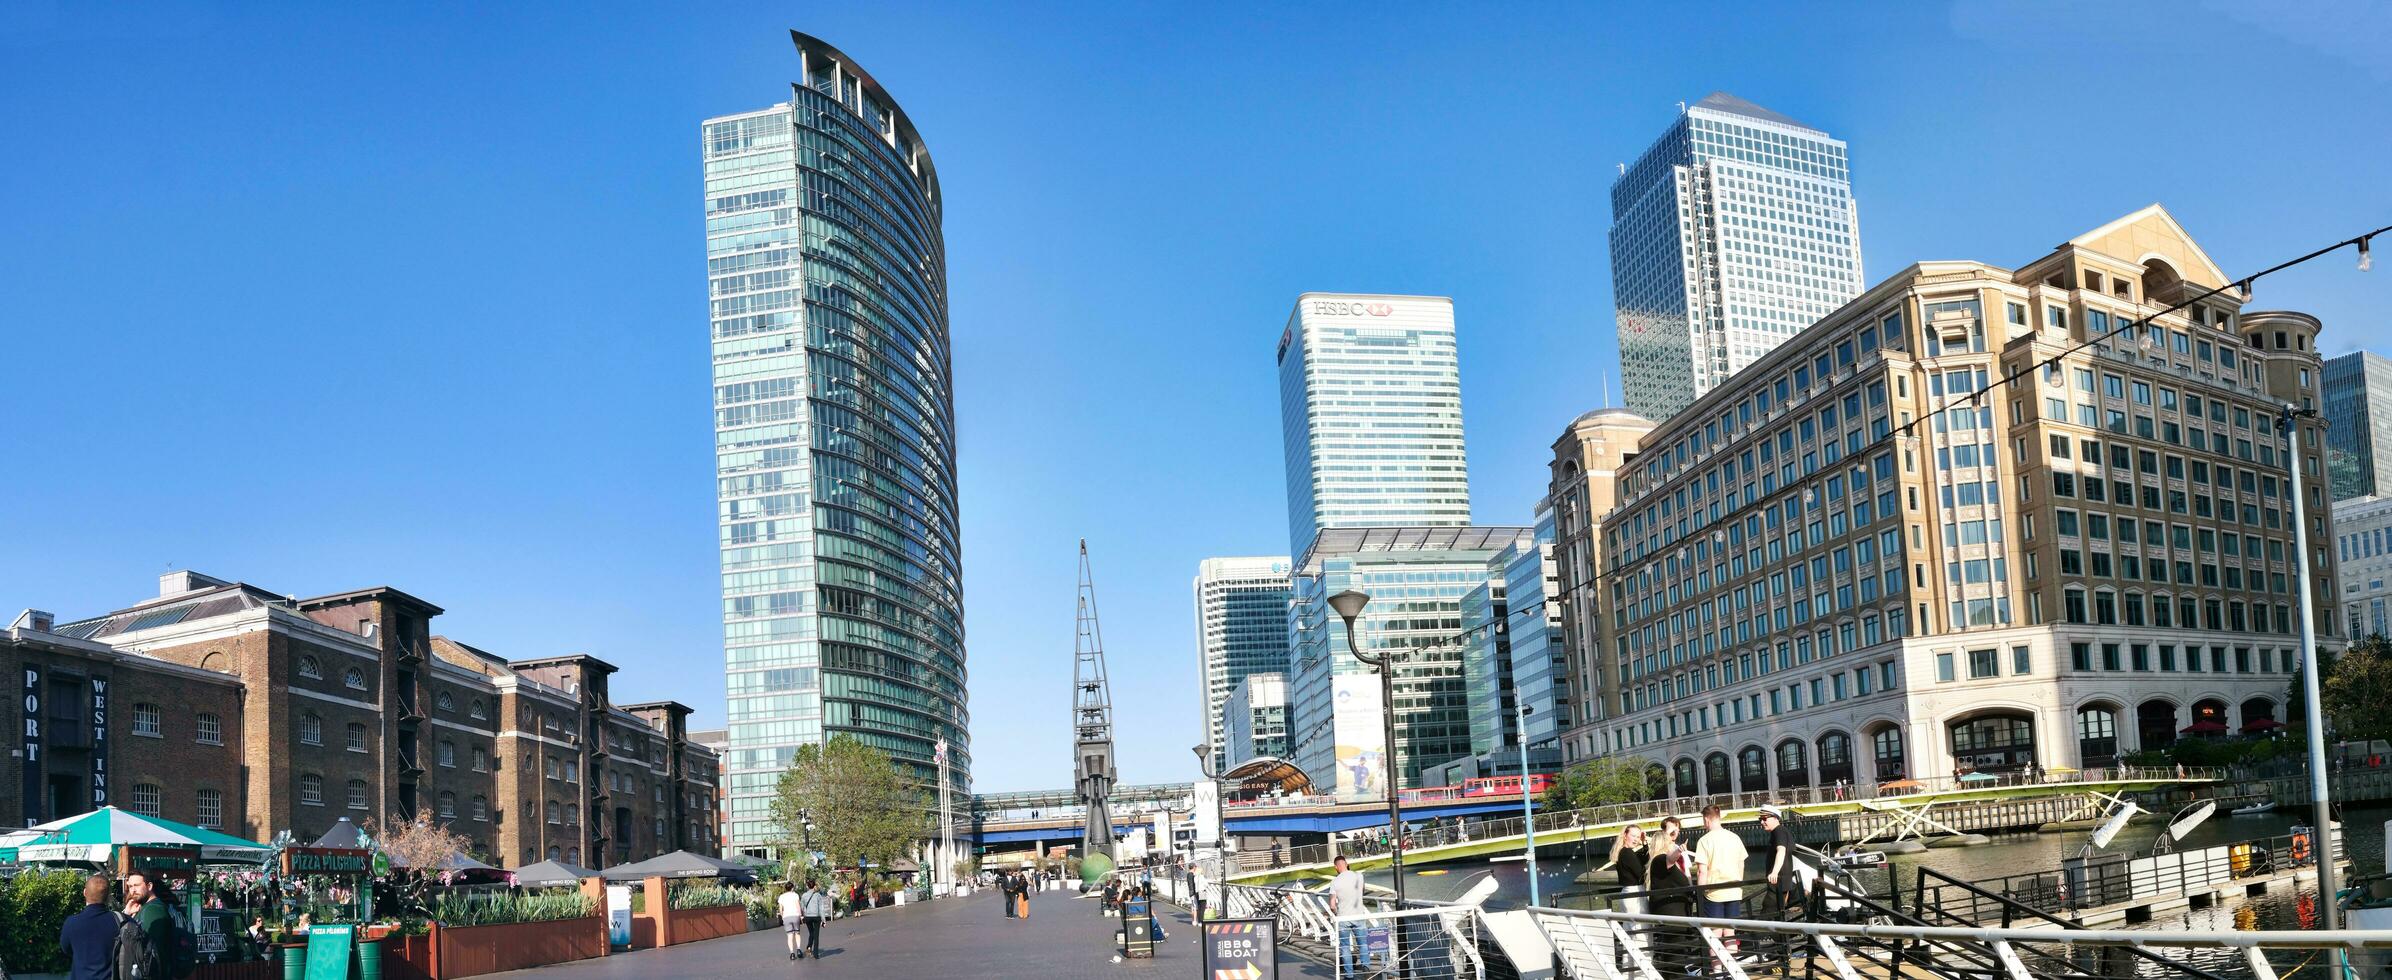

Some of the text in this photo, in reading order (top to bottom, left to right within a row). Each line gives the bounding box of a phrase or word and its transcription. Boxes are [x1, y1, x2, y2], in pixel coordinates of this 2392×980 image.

[1313, 301, 1364, 316] HSBC
[25, 670, 38, 761] PORT
[93, 679, 106, 740] WEST
[291, 853, 321, 871] PIZZA
[322, 855, 366, 871] PILGRIMS
[202, 918, 220, 934] PIZZA
[198, 934, 227, 952] PILGRIMS
[1223, 940, 1252, 949] BBQ
[1224, 948, 1258, 958] BOAT
